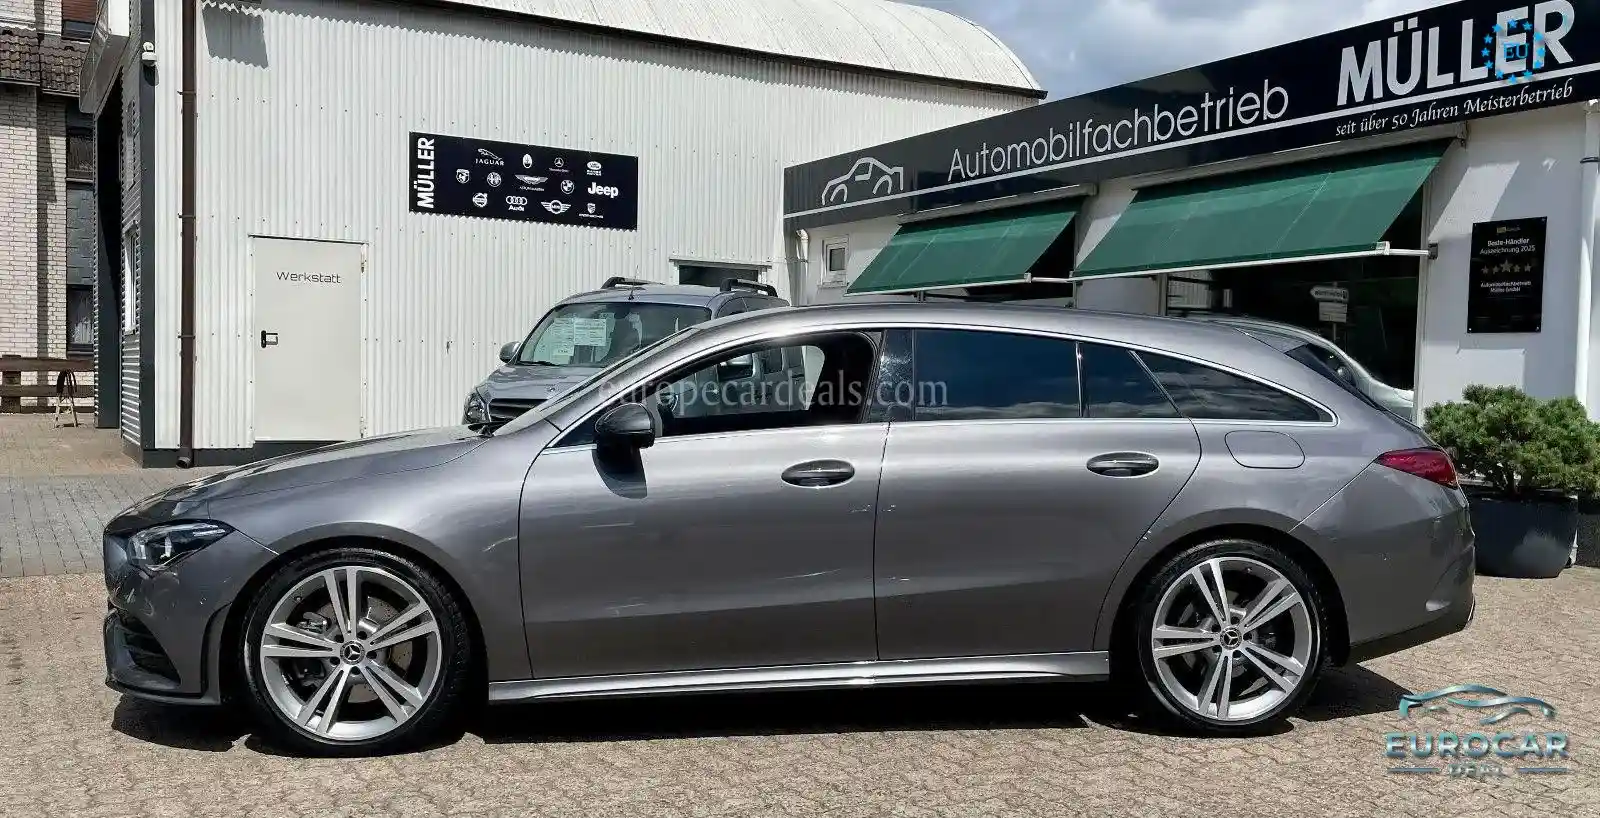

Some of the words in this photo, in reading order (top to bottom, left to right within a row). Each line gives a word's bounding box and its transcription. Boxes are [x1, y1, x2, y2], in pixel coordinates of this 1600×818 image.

[1337, 0, 1575, 106] MÜLLER
[1335, 120, 1356, 137] seit
[1360, 113, 1389, 132] über
[1391, 113, 1408, 130] 50
[1410, 101, 1459, 128] Jahren
[1463, 77, 1574, 116] Meisterbetrieb
[947, 79, 1289, 182] Automobilfachbetrieb
[413, 137, 435, 209] MÜLLER
[475, 158, 505, 166] JAGUAR
[587, 181, 619, 199] Jeep
[1521, 244, 1536, 252] 2025
[276, 271, 342, 284] Werkstatt
